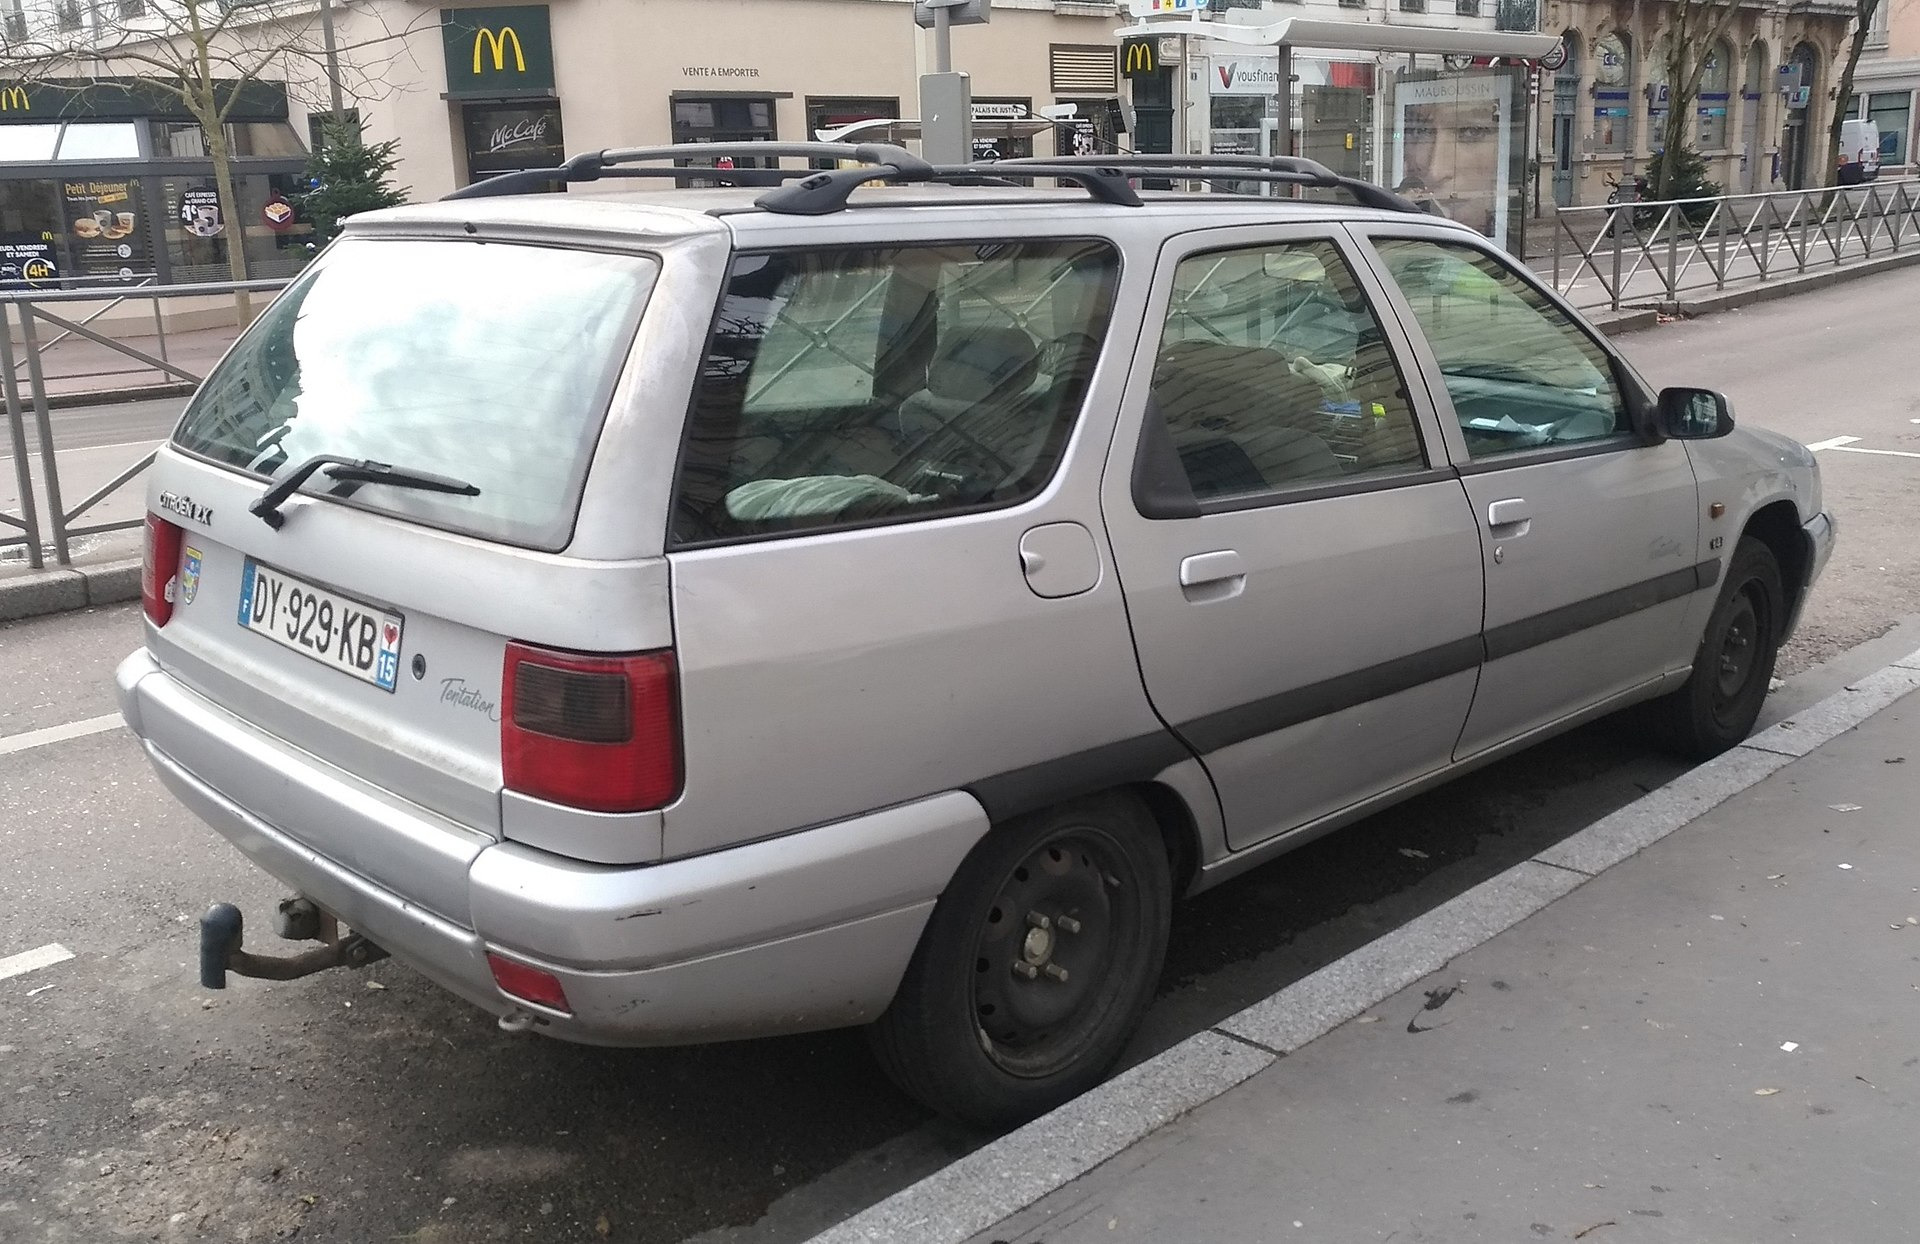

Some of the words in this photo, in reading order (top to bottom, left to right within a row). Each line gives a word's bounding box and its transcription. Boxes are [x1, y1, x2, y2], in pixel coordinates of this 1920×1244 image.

[682, 67, 709, 76] VENTE
[718, 67, 760, 77] EMPORTER
[1237, 69, 1279, 82] vousfinan
[1415, 83, 1490, 97] MAUBOUSSIN
[971, 106, 991, 114] PALAIS
[992, 106, 999, 114] DE
[491, 115, 547, 149] McCafé
[65, 183, 86, 194] Petit
[89, 181, 128, 195] Déjeuner
[29, 264, 48, 277] 4H
[195, 505, 213, 526] ZX
[242, 599, 249, 613] F
[378, 654, 395, 682] 15
[441, 678, 501, 722] Tentation
